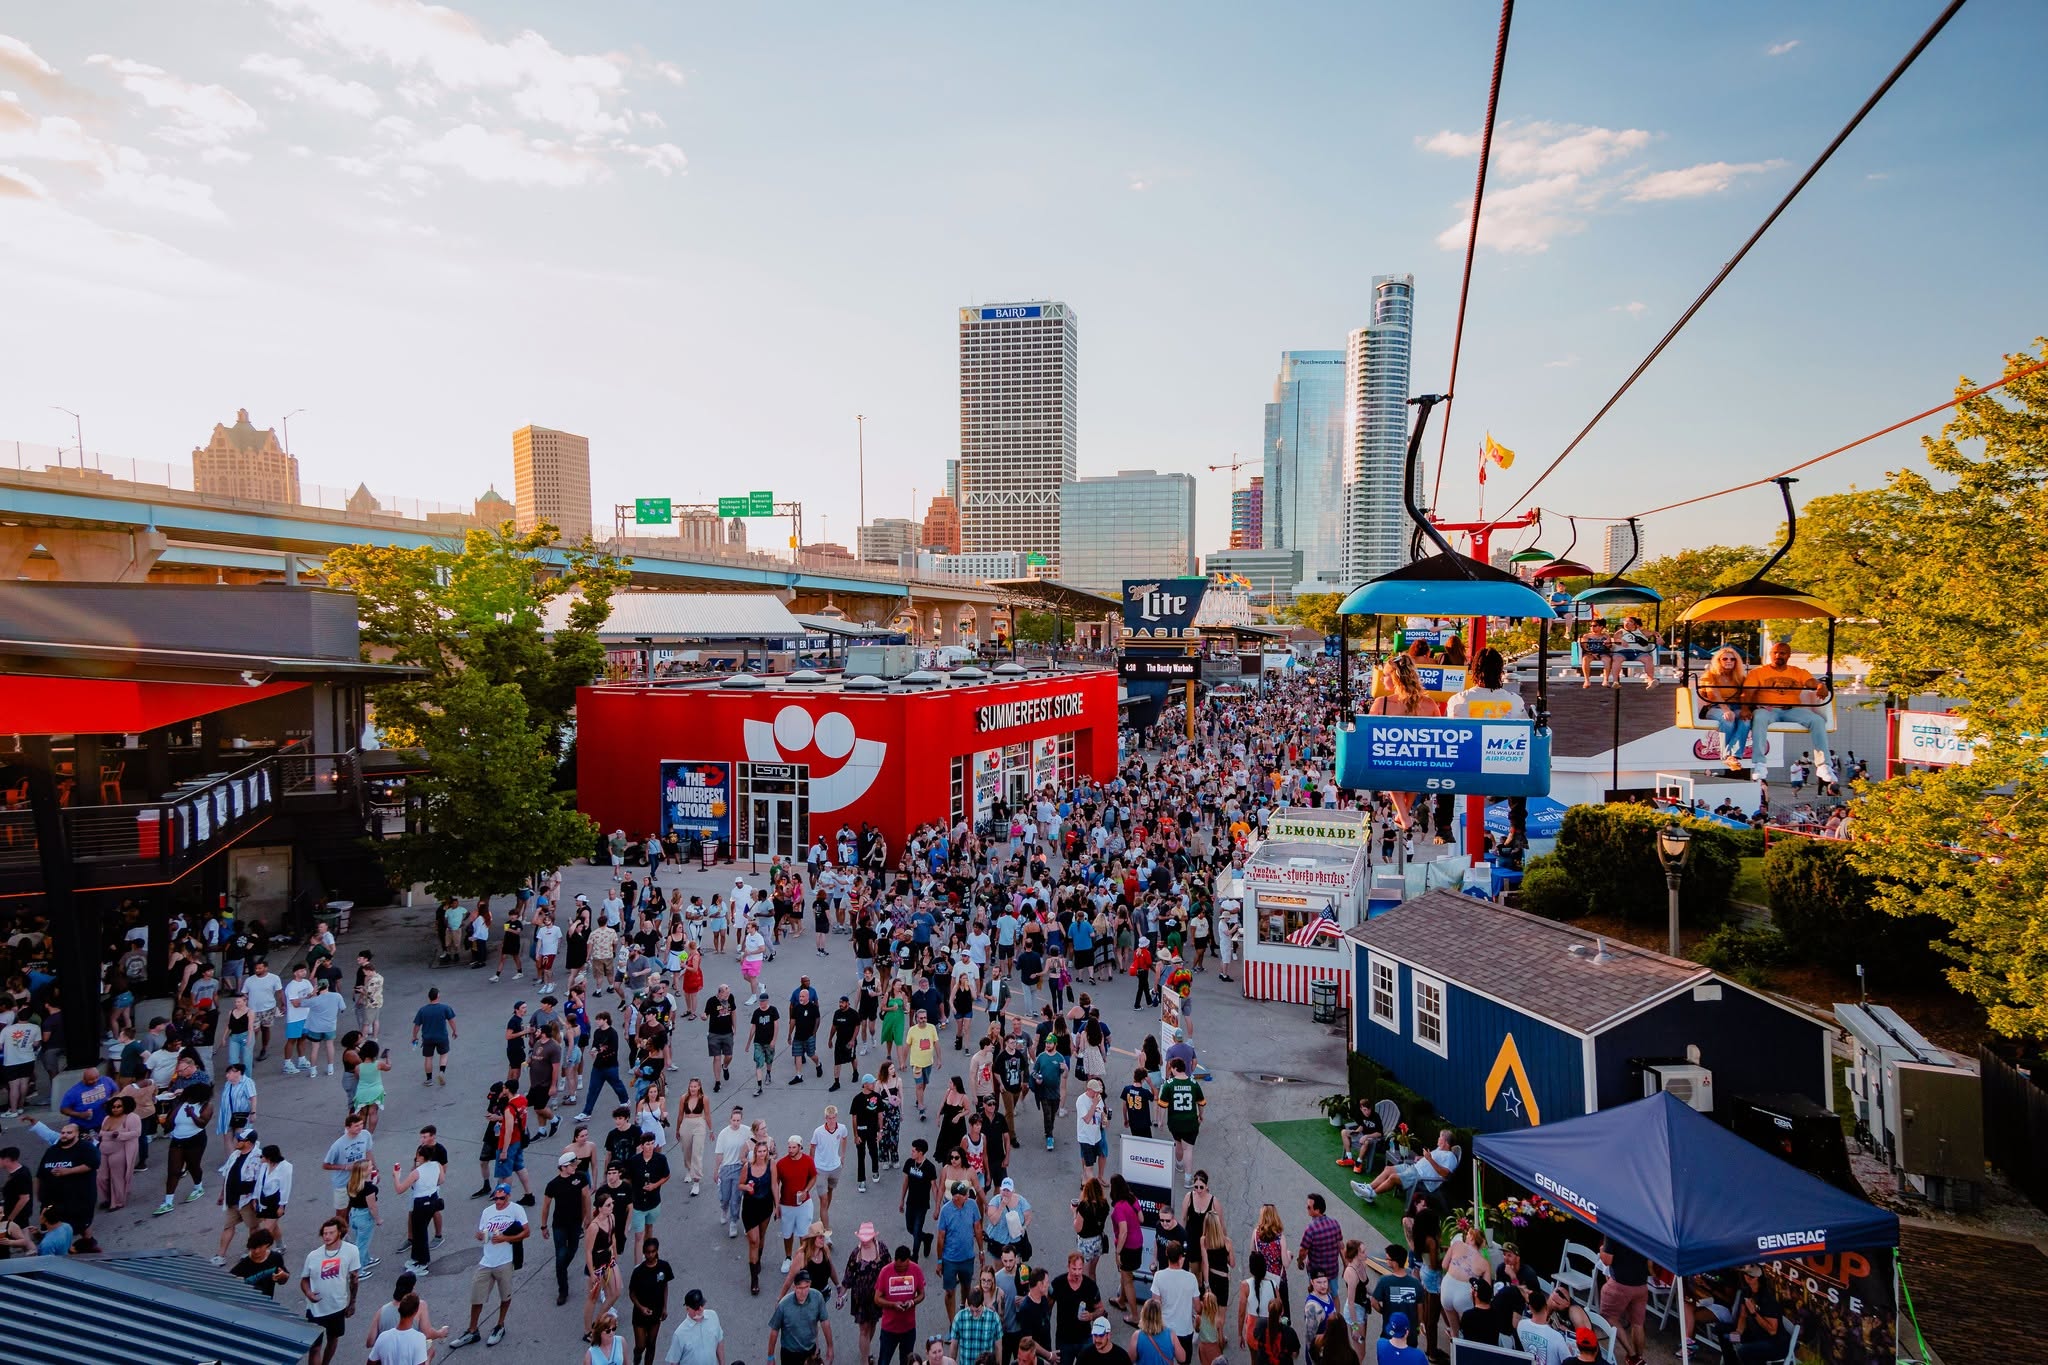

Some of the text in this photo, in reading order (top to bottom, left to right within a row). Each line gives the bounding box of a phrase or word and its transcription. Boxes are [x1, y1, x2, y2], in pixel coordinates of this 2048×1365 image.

[995, 308, 1027, 319] BAIRD
[1474, 534, 1484, 545] 5
[1140, 592, 1188, 622] Lite
[1119, 627, 1200, 638] OASIS
[786, 640, 807, 650] MILER
[813, 639, 826, 648] LITE
[1146, 663, 1157, 672] The
[1156, 663, 1173, 674] Dandy
[980, 692, 1084, 733] SUMMERFEST STORE
[1372, 727, 1473, 744] NONSTOP
[1372, 743, 1459, 759] SEATTLE
[1486, 737, 1528, 750] MKE
[1372, 759, 1455, 769] TWO FLIGHTS DAILY
[1485, 755, 1524, 763] AIRPORT
[684, 772, 707, 787] THE
[1426, 778, 1456, 790] 59
[666, 786, 725, 803] SUMMERFEST
[677, 803, 714, 819] STORE
[1275, 824, 1357, 840] LEMONADE
[1249, 872, 1281, 880] LEMONADE
[1287, 868, 1345, 885] STUFFED PRETZELS
[1173, 1092, 1193, 1111] 23
[1130, 1154, 1164, 1165] GENERAC
[1534, 1172, 1598, 1216] GENERAC
[1757, 1229, 1827, 1250] GENERAC
